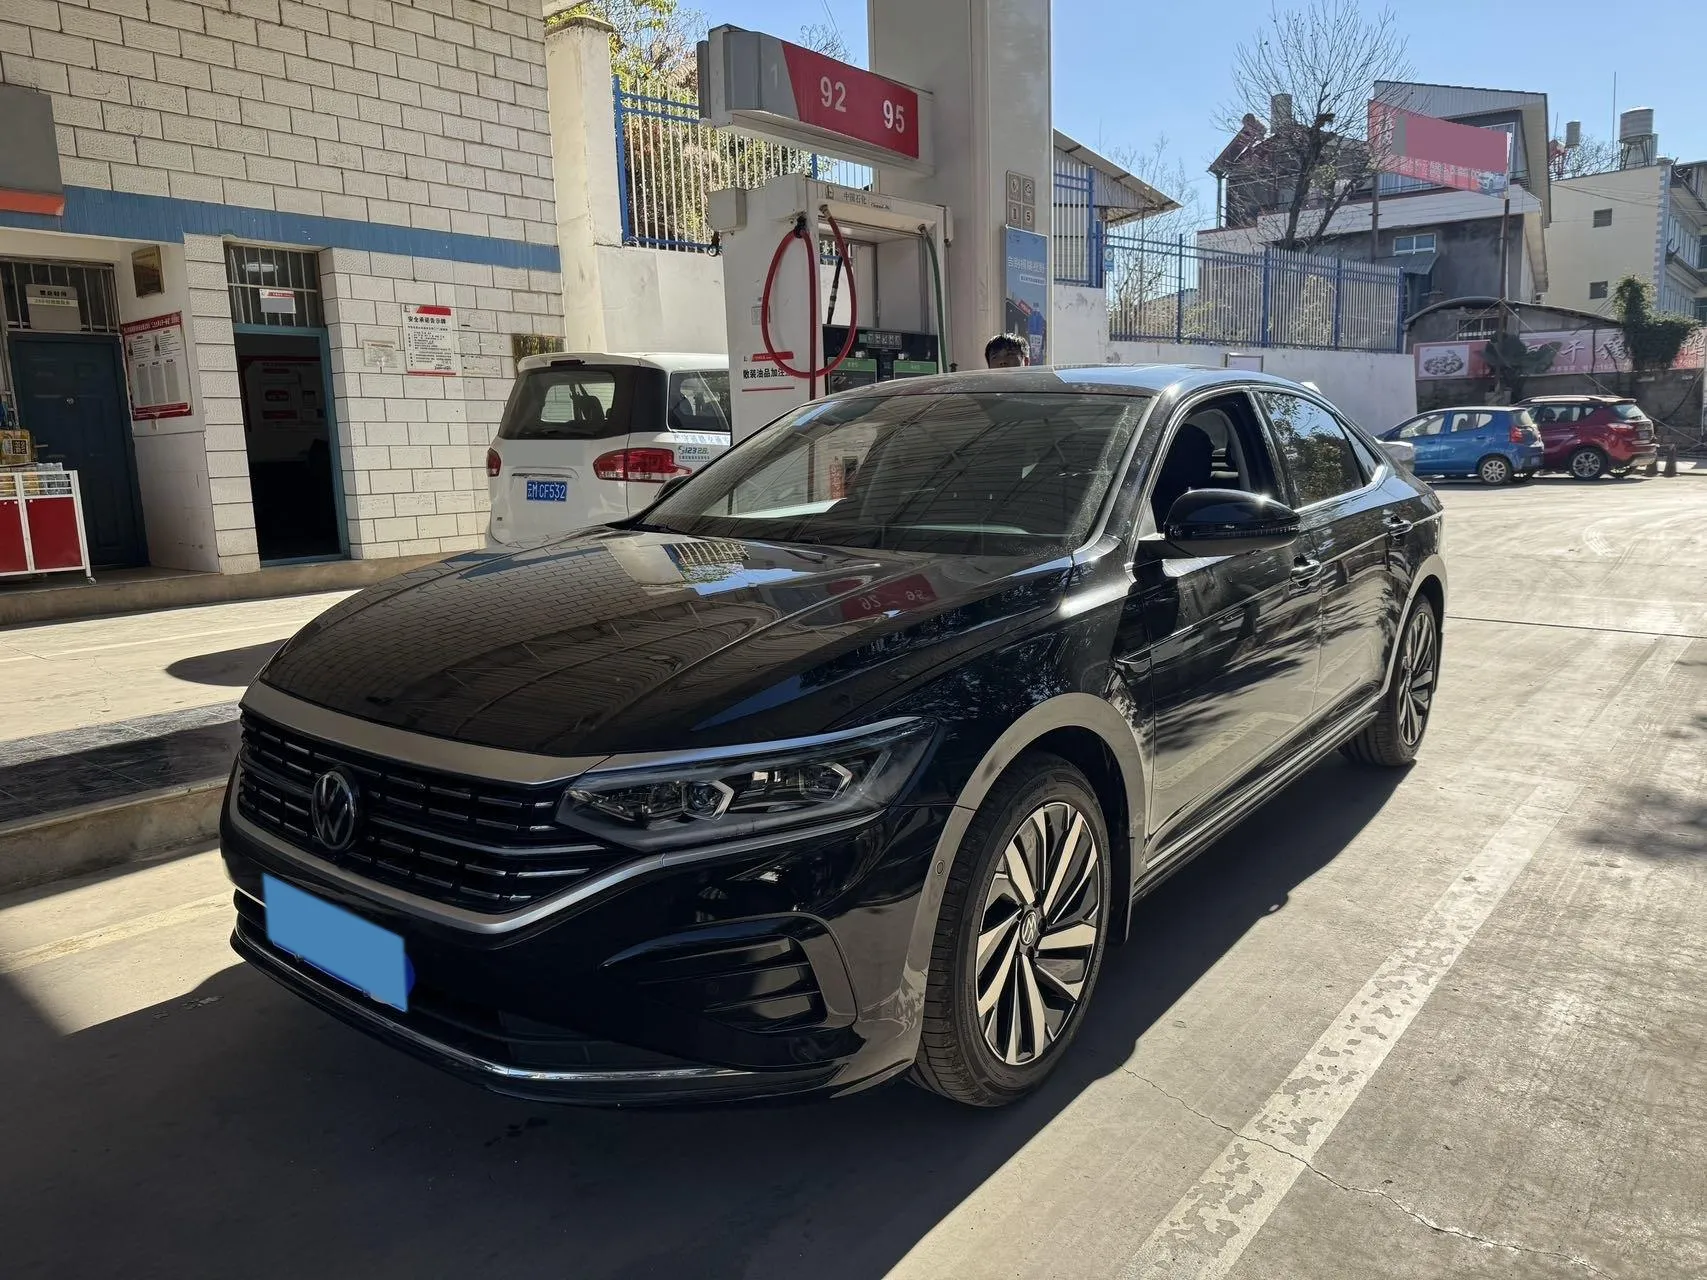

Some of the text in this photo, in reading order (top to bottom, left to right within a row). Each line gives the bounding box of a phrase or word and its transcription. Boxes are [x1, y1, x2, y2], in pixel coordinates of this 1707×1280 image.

[770, 64, 778, 88] 1
[820, 76, 905, 134] 92 95
[844, 191, 867, 205] 中国石化
[743, 367, 790, 379] 散装油品加注
